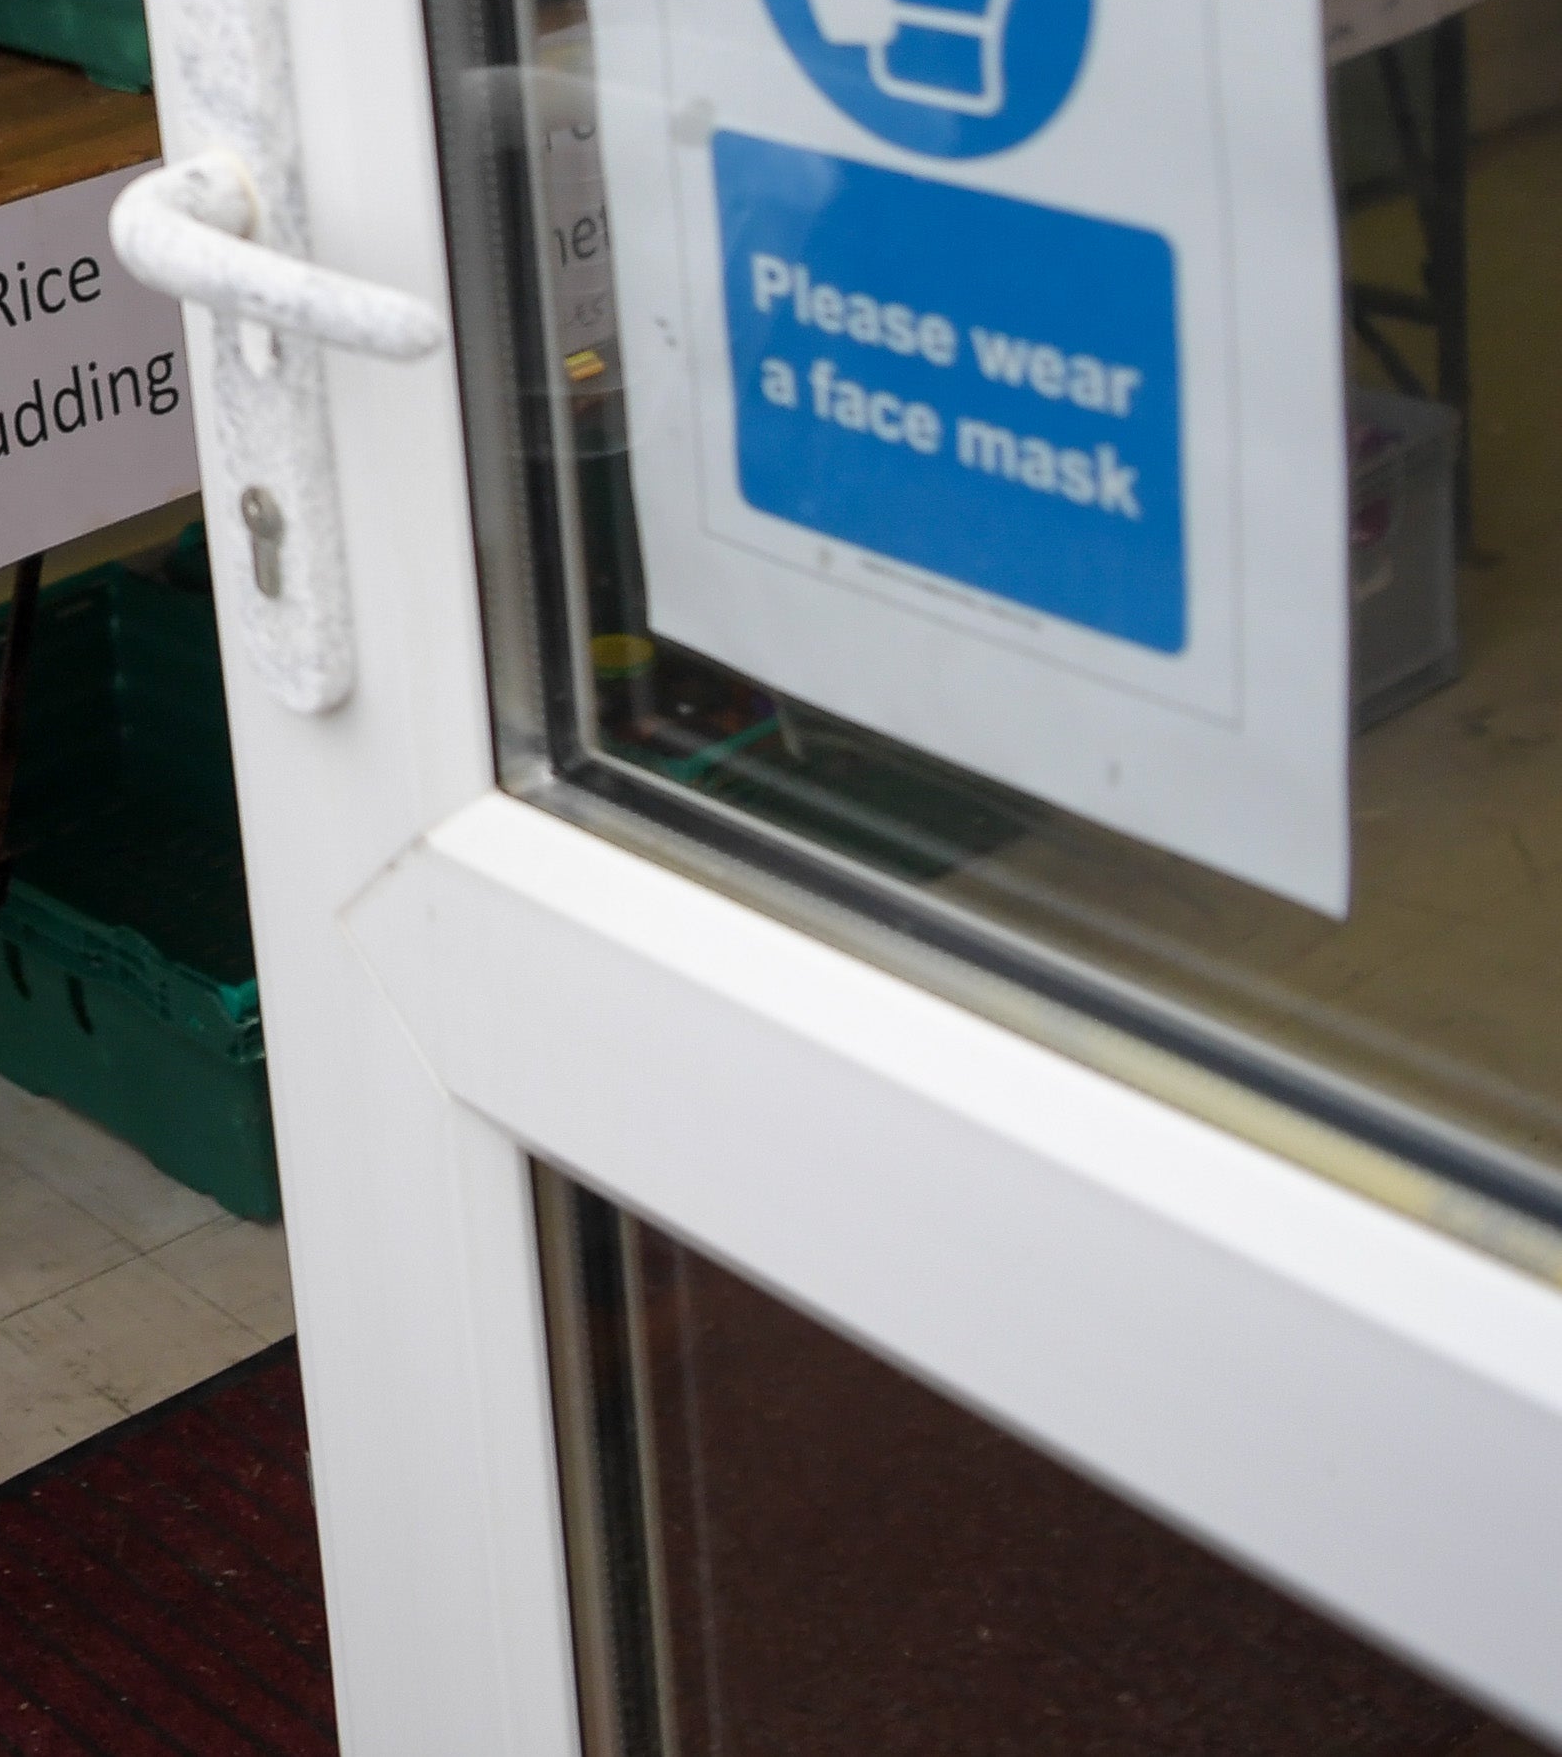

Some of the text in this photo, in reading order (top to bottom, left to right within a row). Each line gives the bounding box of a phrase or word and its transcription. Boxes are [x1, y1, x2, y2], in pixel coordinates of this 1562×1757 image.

[750, 252, 1144, 419] Please wear
[760, 356, 1144, 522] a face mask
